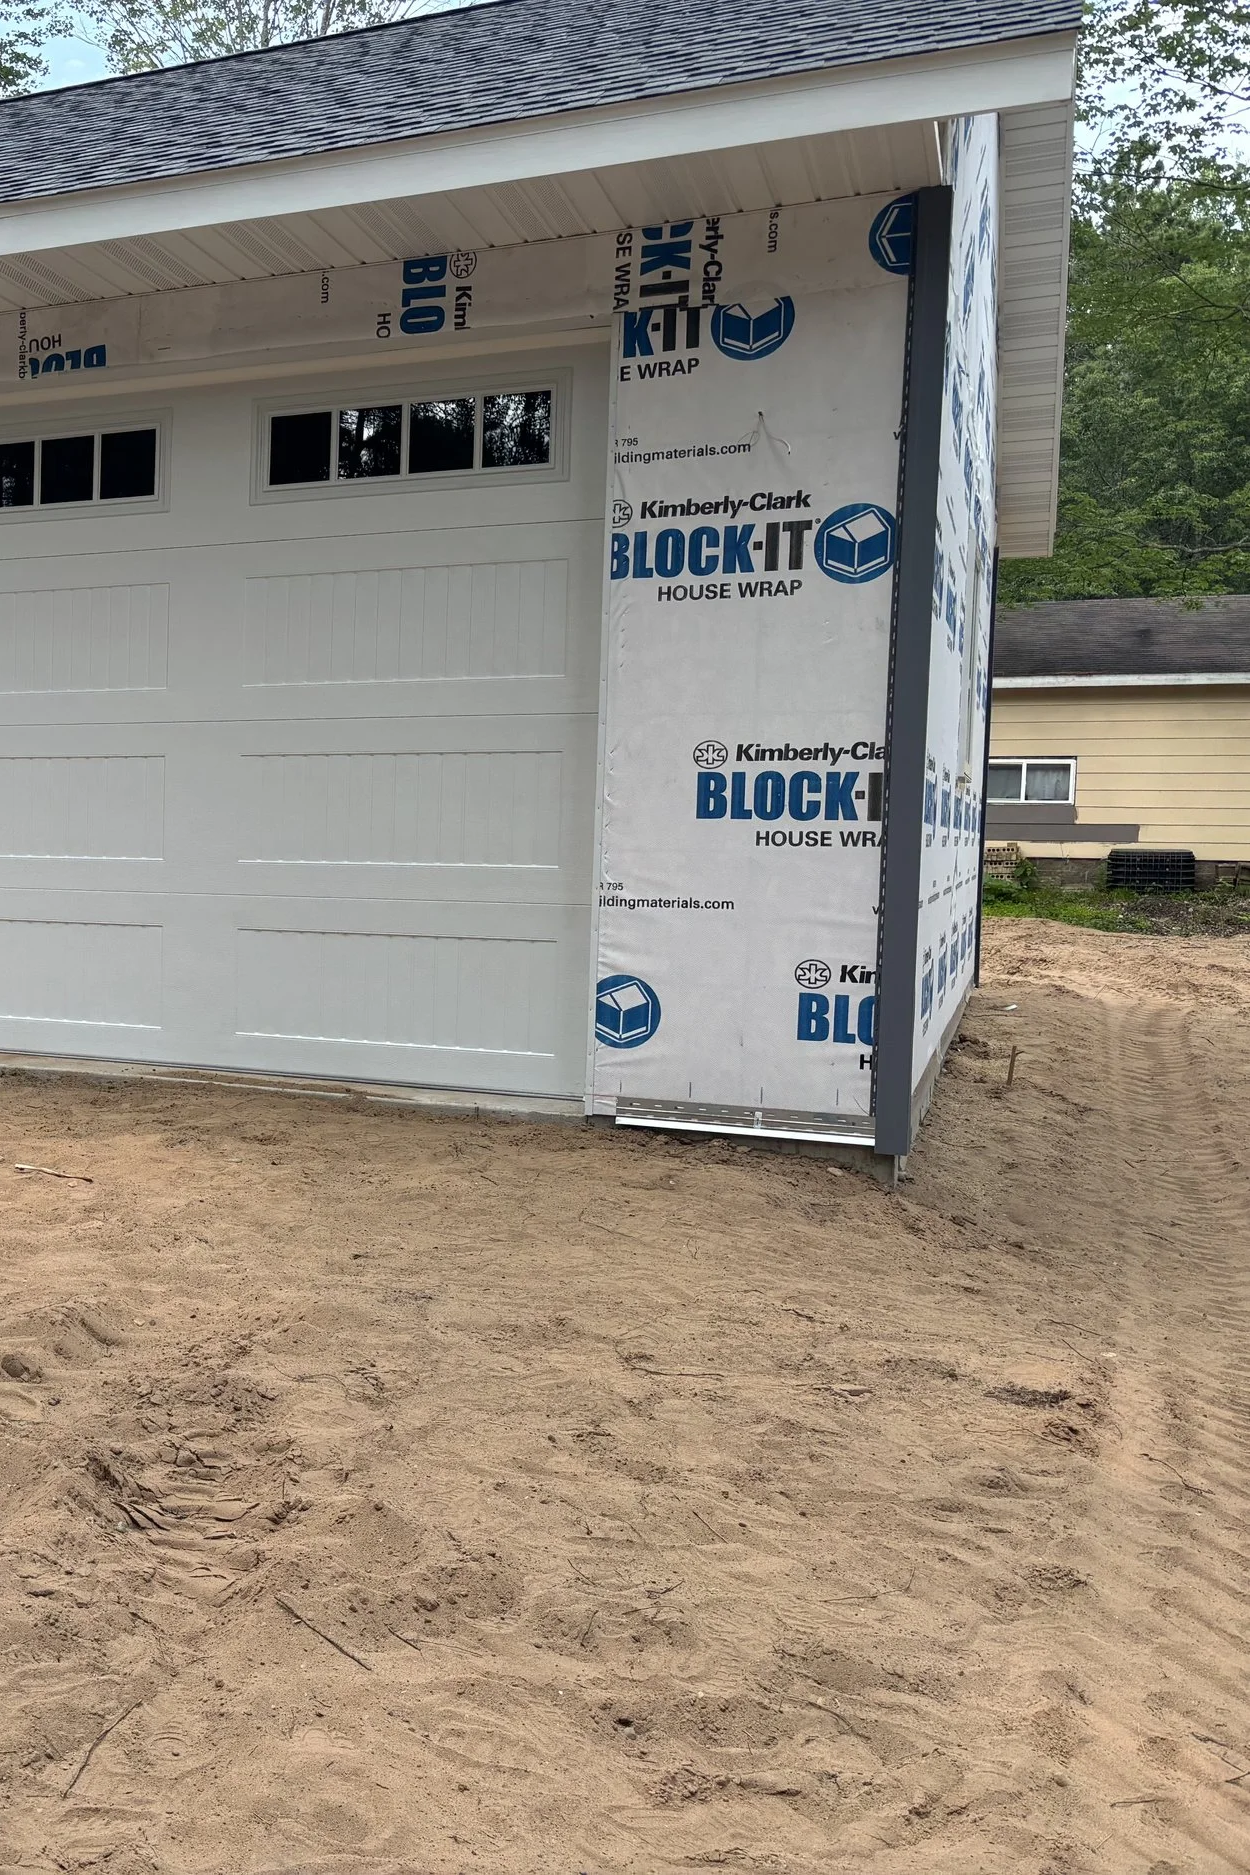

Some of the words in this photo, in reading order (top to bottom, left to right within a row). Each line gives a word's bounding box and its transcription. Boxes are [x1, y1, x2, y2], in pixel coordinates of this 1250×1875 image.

[400, 256, 448, 335] BLO
[376, 313, 391, 339] HO
[637, 358, 700, 380] WRAP
[621, 438, 638, 447] 795
[640, 490, 812, 519] Kimberly-Clark
[610, 519, 814, 580] BLOCK-IT
[657, 582, 732, 602] HOUSE
[738, 580, 803, 599] WRAP
[755, 830, 832, 847] HOUSE
[607, 882, 623, 891] 795
